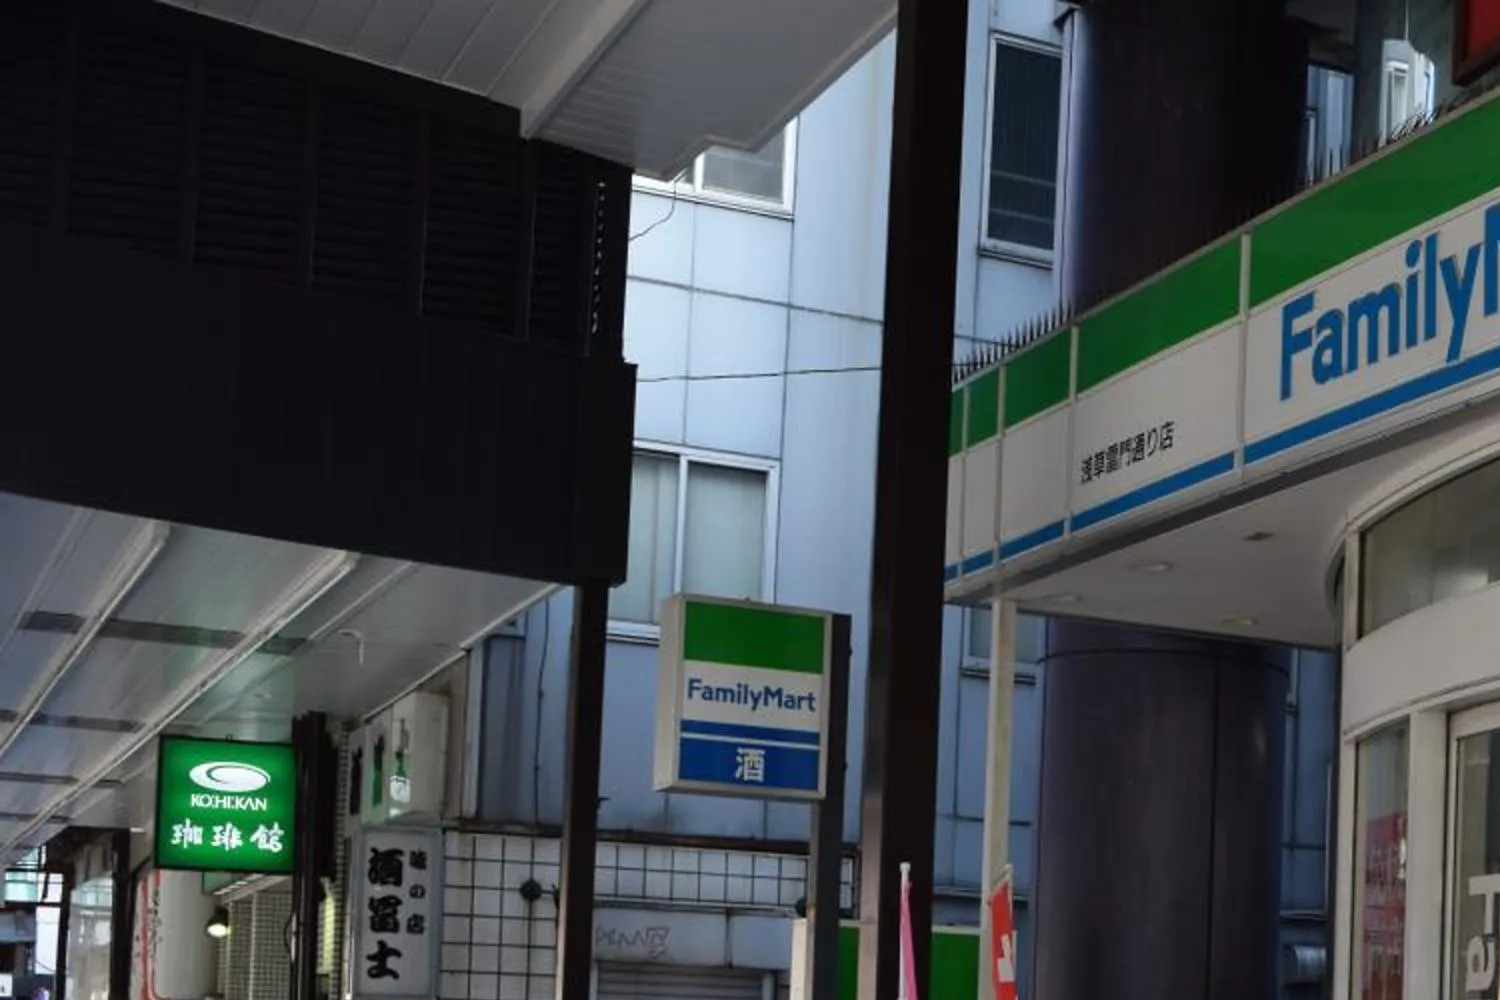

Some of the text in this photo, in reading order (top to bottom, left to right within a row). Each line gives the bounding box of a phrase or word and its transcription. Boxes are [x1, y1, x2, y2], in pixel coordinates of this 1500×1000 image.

[1081, 421, 1175, 485] 浅草雷門通り店
[687, 679, 817, 714] FamilyMart
[735, 749, 765, 783] 酒
[170, 818, 285, 853] 珈琲館
